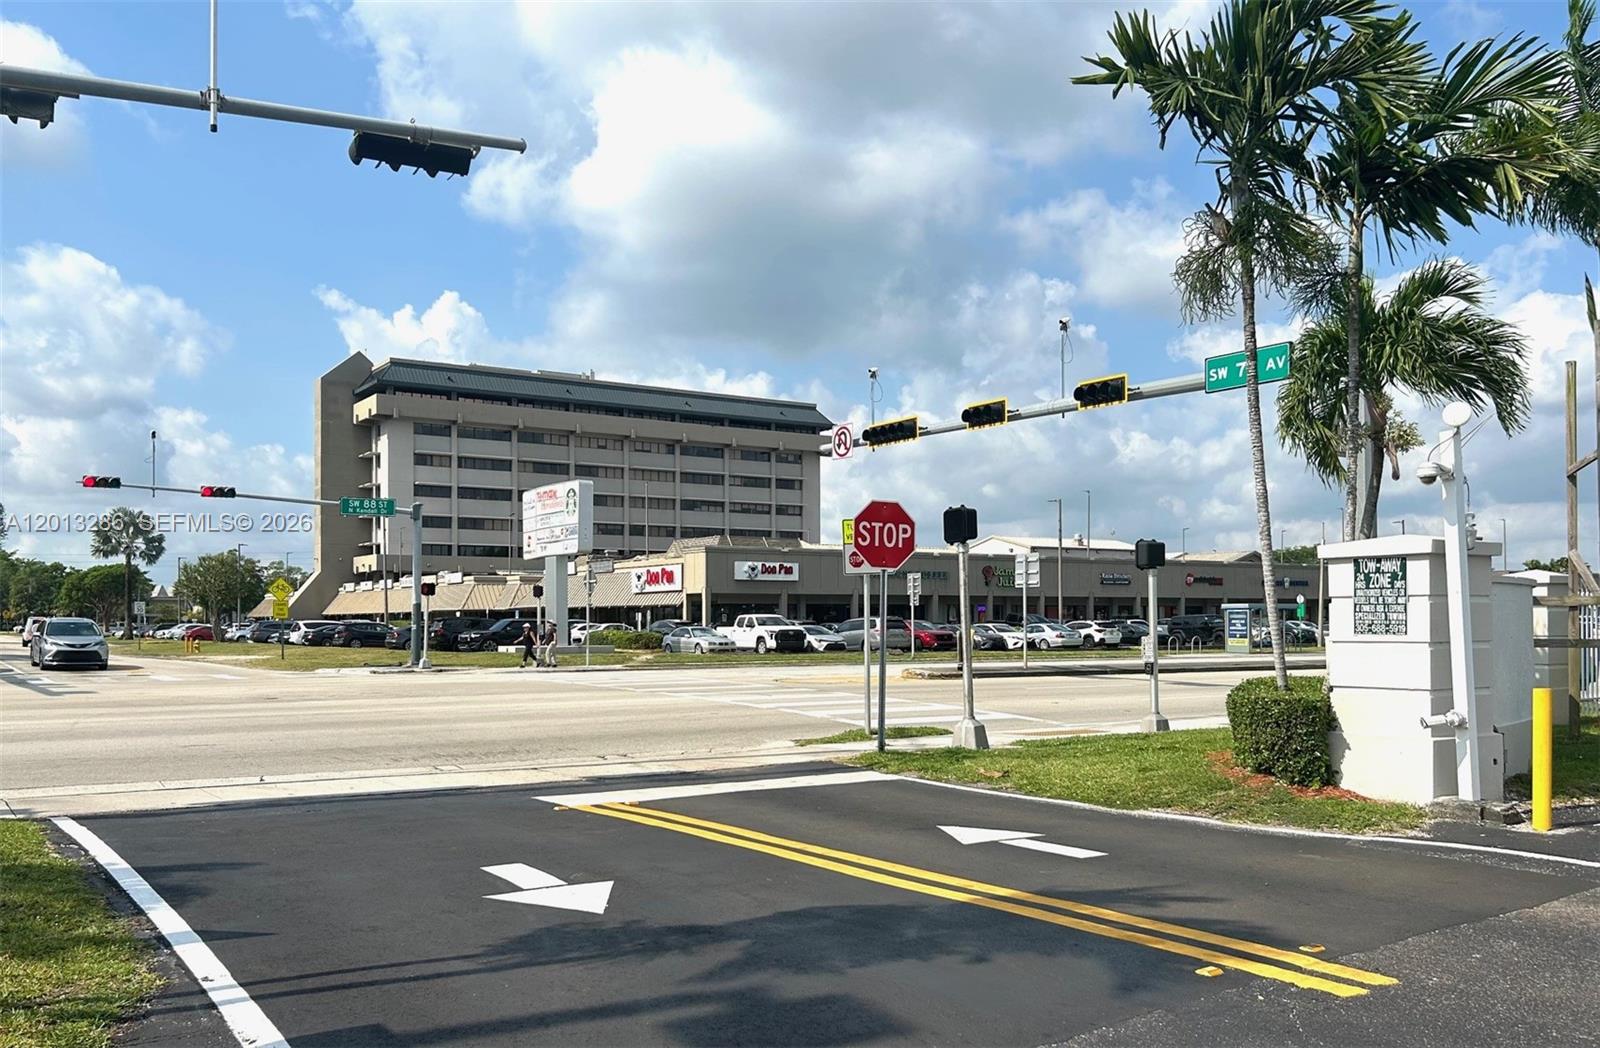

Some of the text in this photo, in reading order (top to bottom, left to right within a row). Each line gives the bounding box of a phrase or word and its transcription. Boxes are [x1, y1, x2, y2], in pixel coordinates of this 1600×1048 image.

[1209, 366, 1228, 382] SW
[1265, 355, 1286, 371] AV
[363, 499, 377, 509] 88
[858, 520, 912, 548] STOP
[761, 563, 794, 575] Don Pan
[992, 566, 1015, 576] Jam
[1358, 558, 1401, 573] TOW-AWAY
[646, 567, 674, 586] Don Pan
[997, 577, 1015, 587] Jui
[1356, 573, 1365, 581] 24
[1369, 573, 1392, 588] ZONE
[1397, 572, 1403, 580] 7
